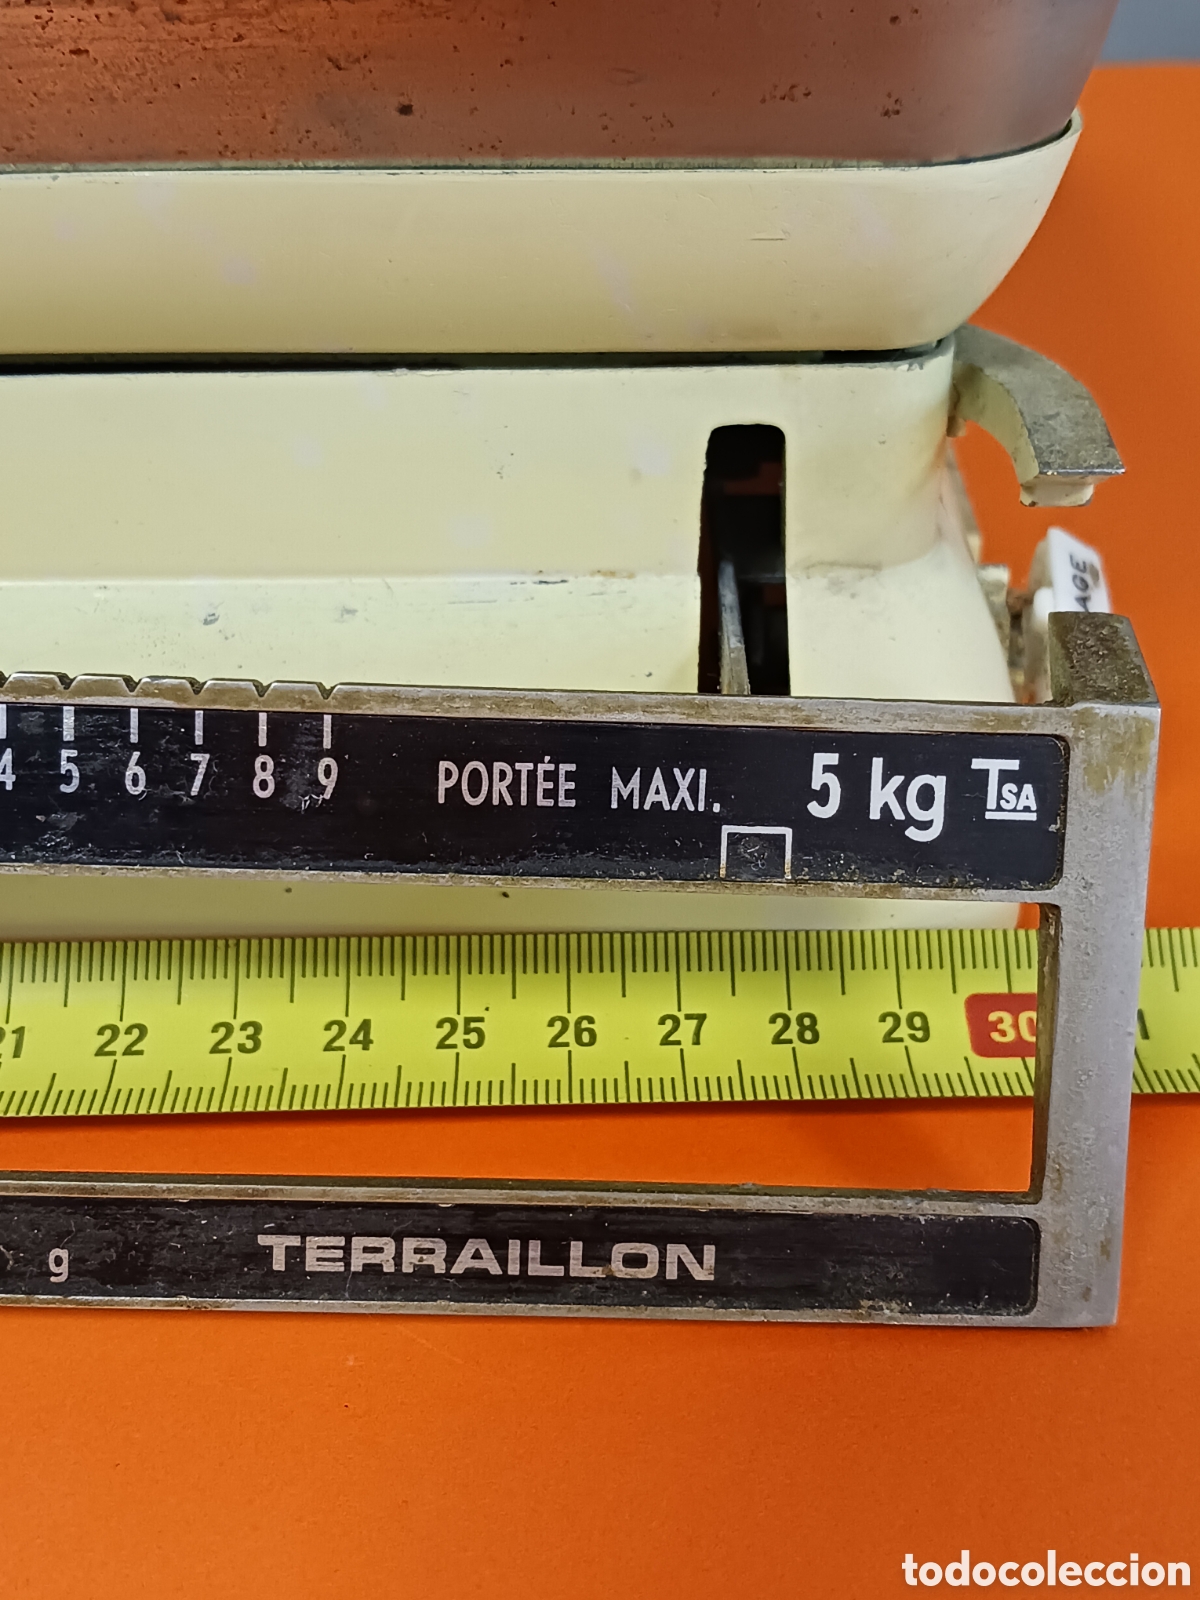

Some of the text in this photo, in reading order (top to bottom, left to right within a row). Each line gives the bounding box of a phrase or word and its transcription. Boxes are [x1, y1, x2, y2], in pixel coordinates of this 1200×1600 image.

[0, 748, 338, 800] 4 5 6 7 8 9
[437, 752, 947, 842] PORTÉE MAXI. 5 kg
[94, 1023, 149, 1057] 22
[209, 1021, 263, 1055] 23
[323, 1019, 374, 1052] 24
[435, 1017, 486, 1050] 25
[547, 1015, 598, 1048] 26
[657, 1013, 708, 1046] 27
[768, 1012, 820, 1046] 28
[878, 1011, 931, 1043] 29
[48, 1248, 69, 1283] g
[257, 1234, 716, 1281] TERRAILLON
